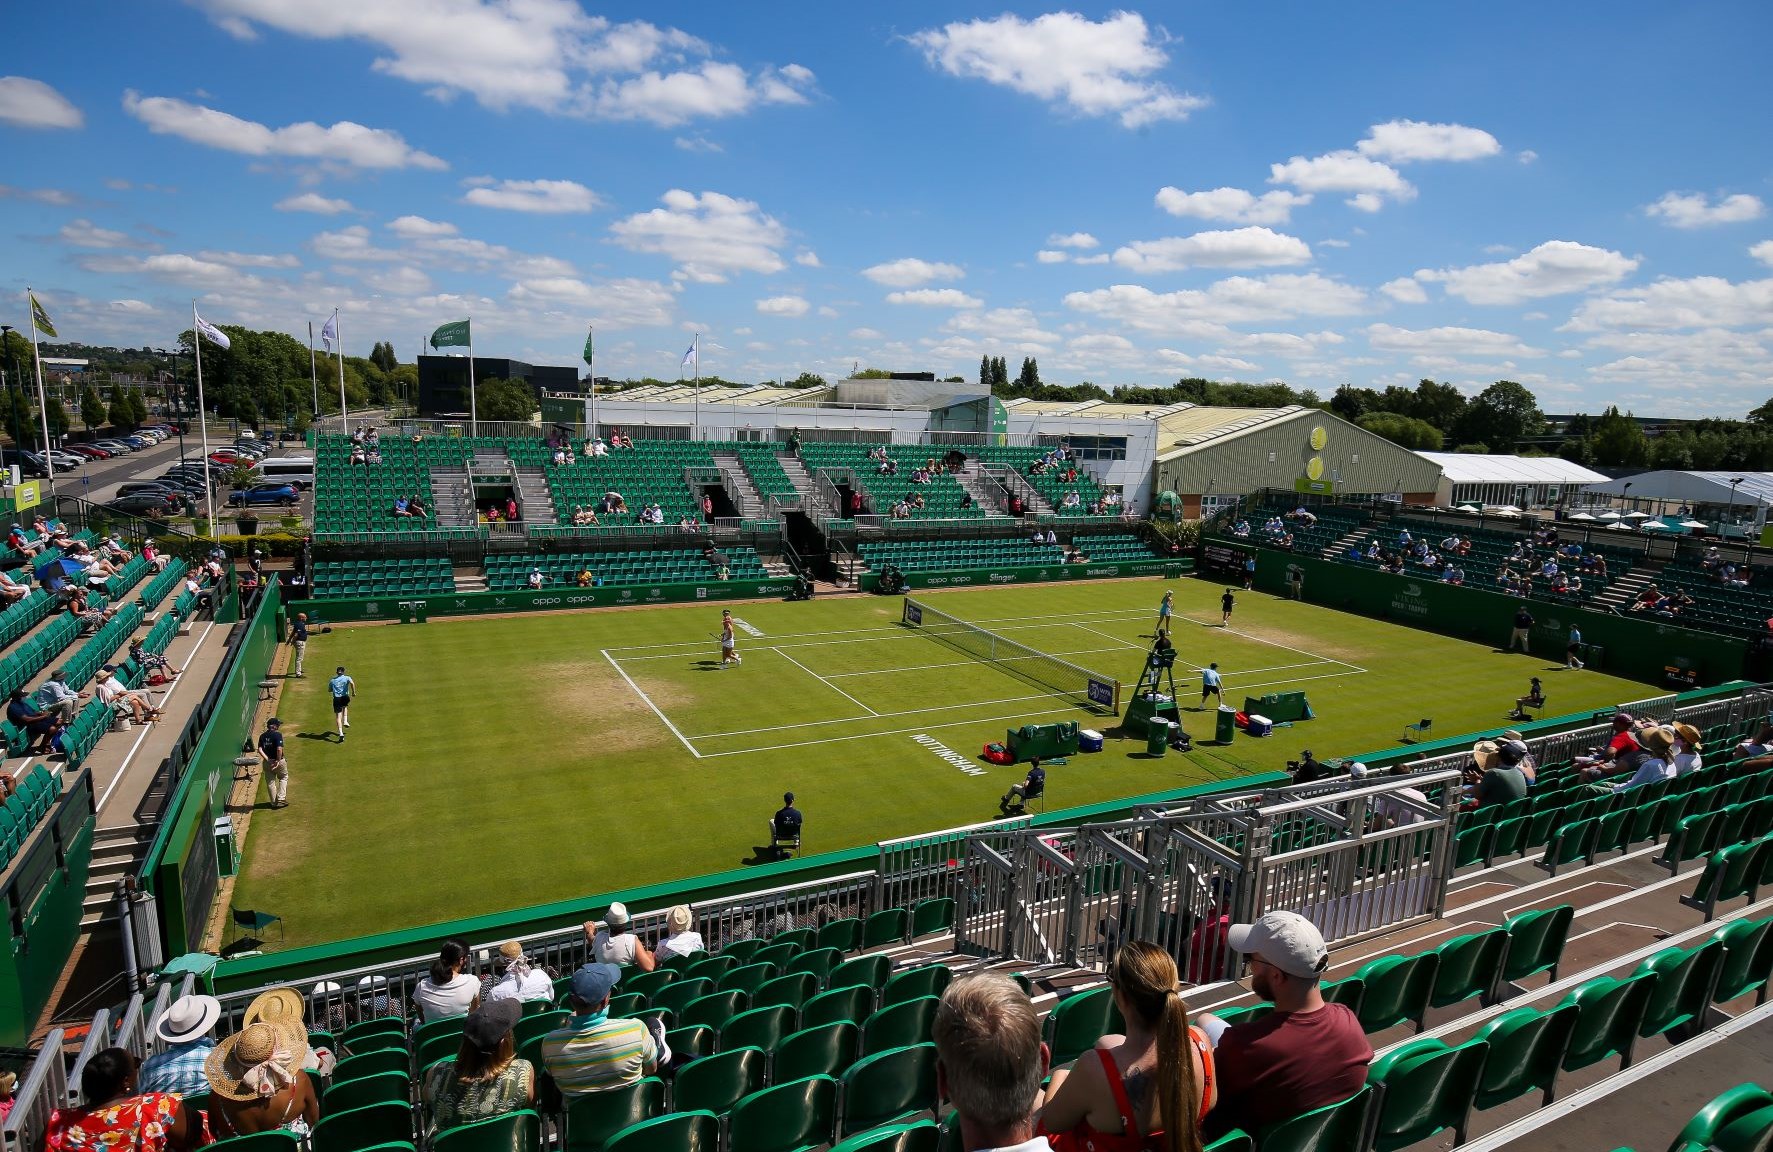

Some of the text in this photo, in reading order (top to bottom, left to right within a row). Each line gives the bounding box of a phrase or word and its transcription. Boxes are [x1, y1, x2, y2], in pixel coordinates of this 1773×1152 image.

[927, 577, 947, 585] oppo
[532, 594, 595, 606] oppo oppo
[909, 734, 989, 776] NOTTINGHAM
